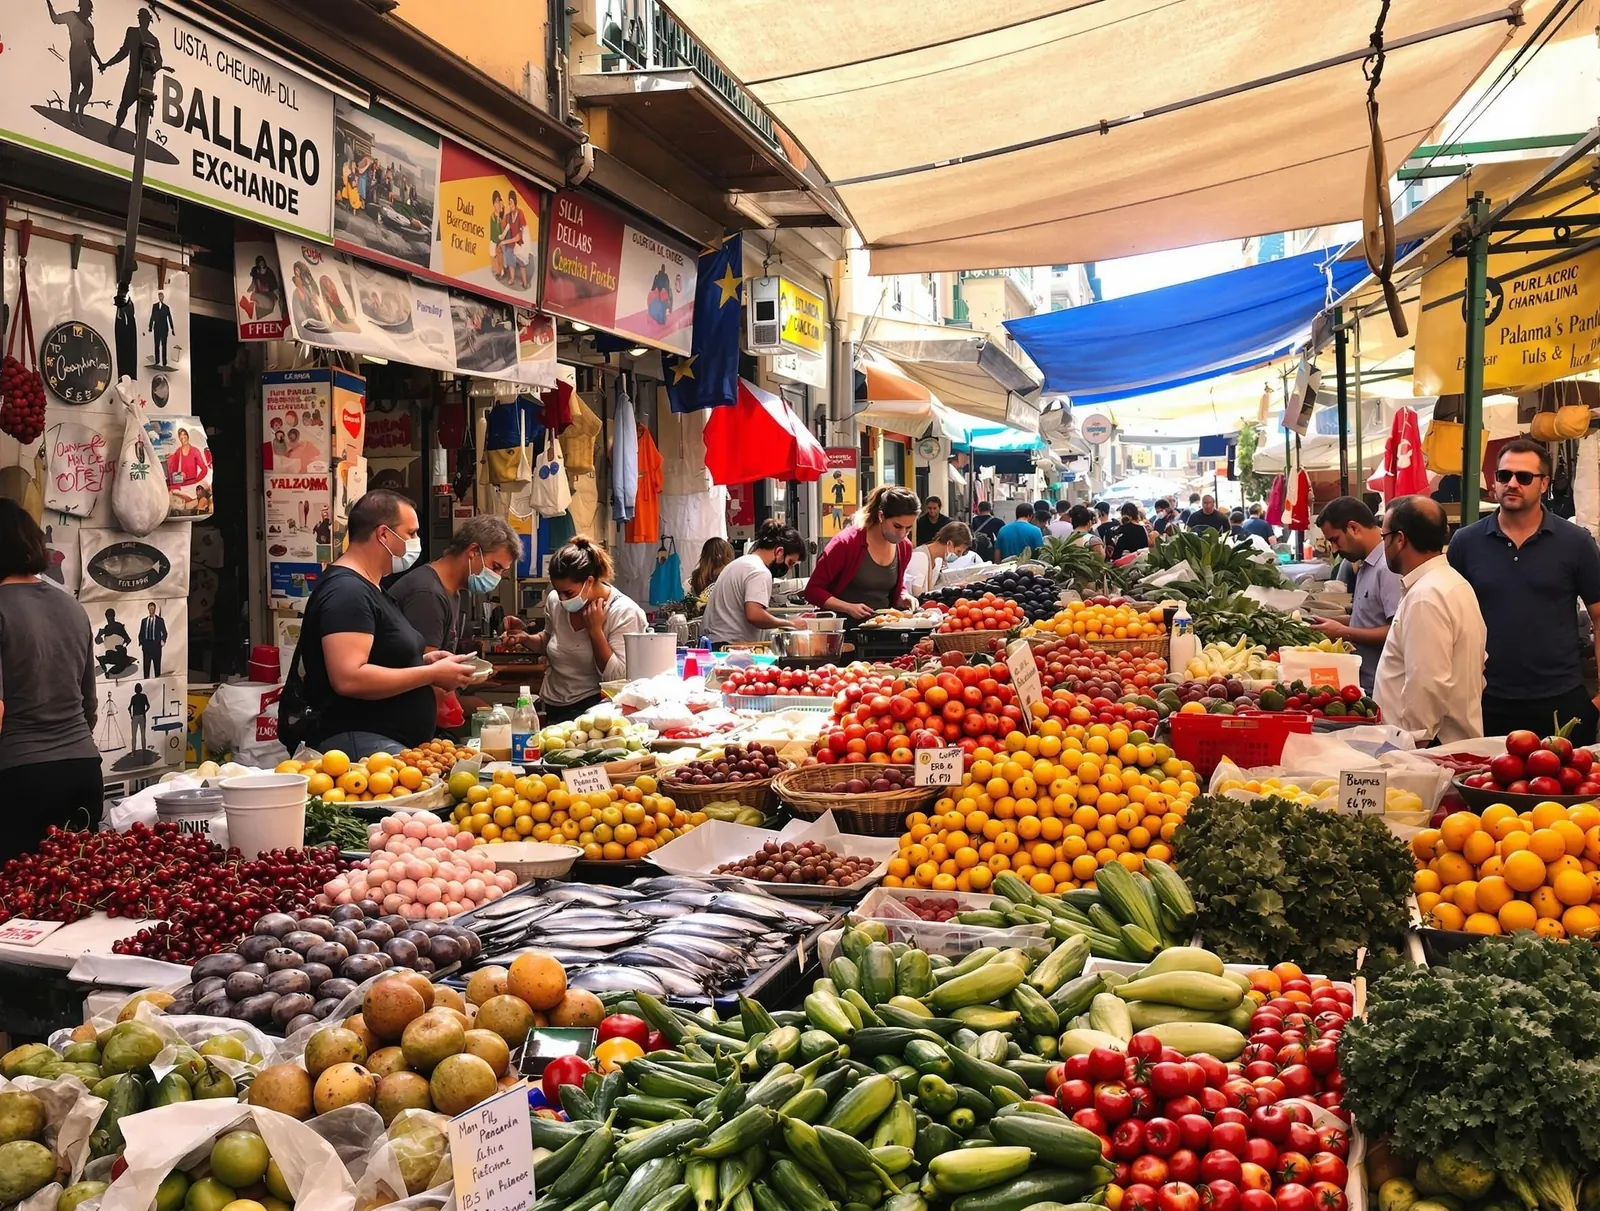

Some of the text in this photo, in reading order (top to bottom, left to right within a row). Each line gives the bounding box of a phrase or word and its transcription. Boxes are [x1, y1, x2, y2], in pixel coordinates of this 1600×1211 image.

[174, 27, 212, 67] UISTA.
[278, 82, 299, 111] DLL
[162, 74, 320, 186] BALLARO
[192, 148, 299, 216] EXCHANDE
